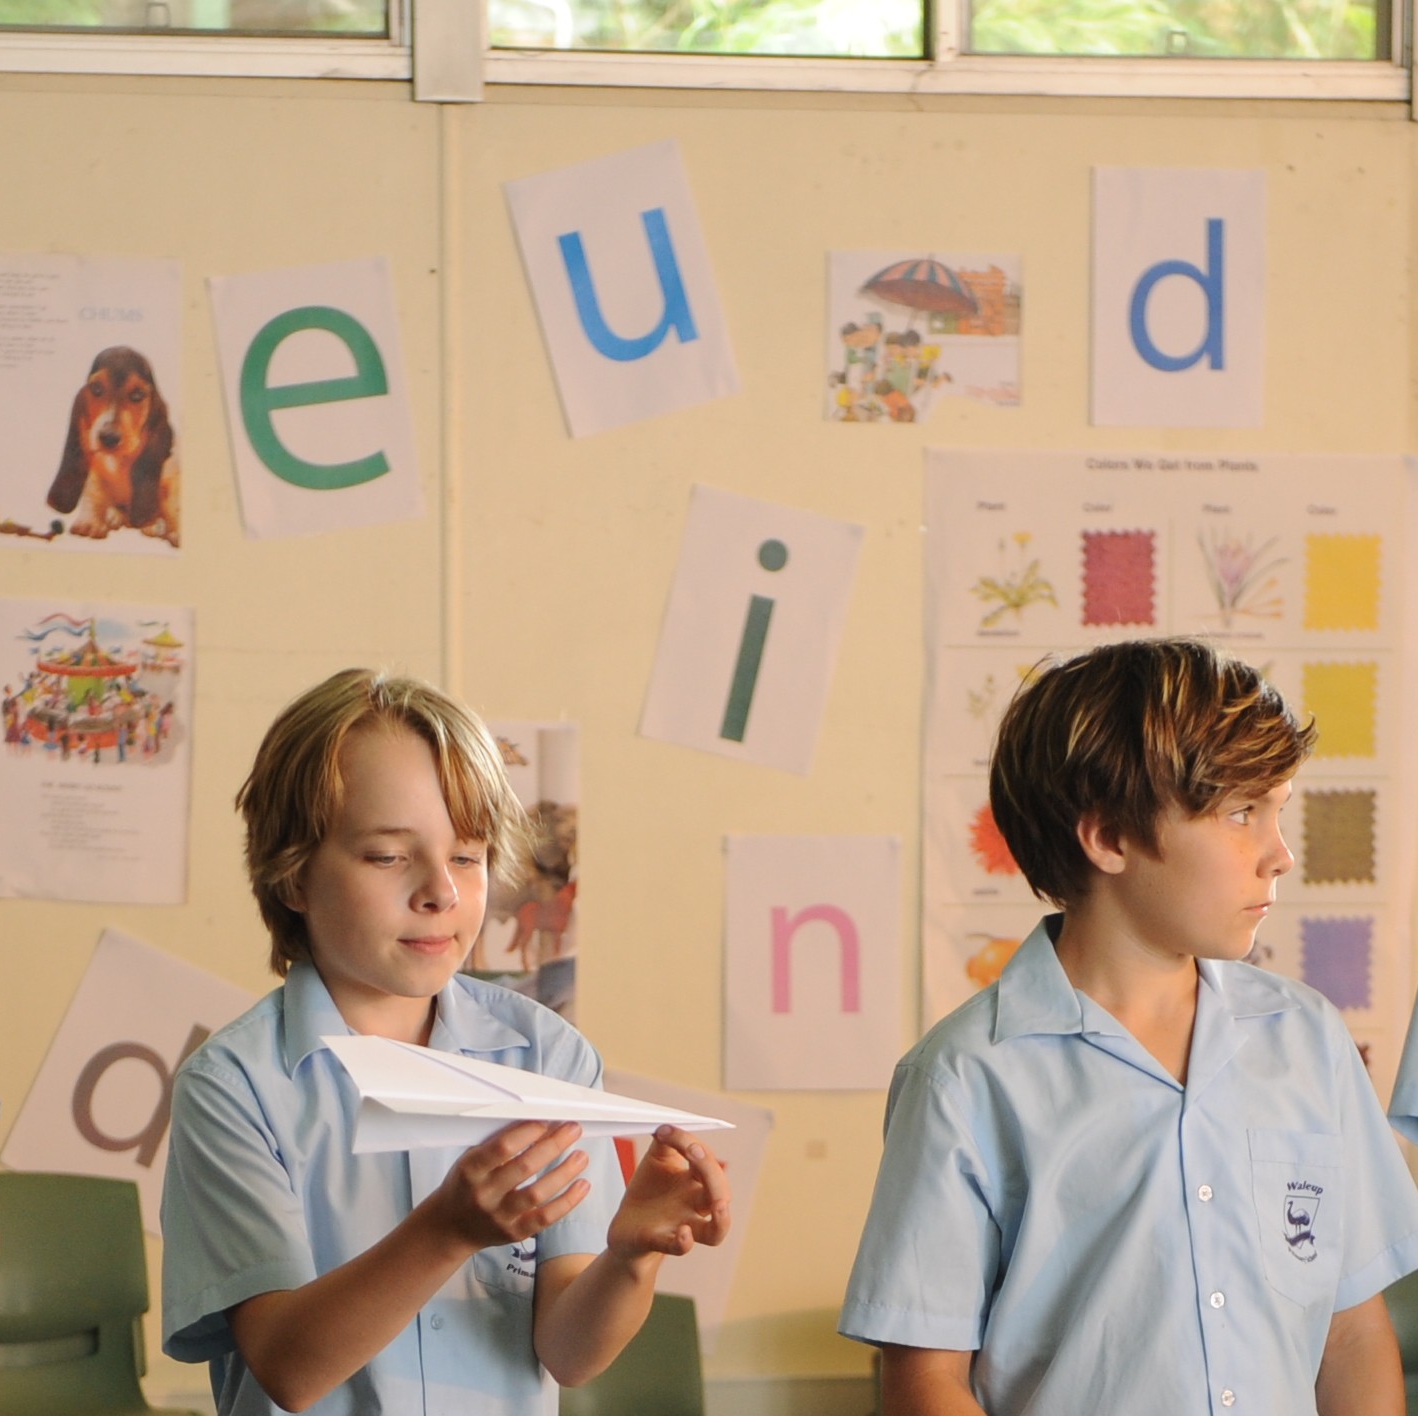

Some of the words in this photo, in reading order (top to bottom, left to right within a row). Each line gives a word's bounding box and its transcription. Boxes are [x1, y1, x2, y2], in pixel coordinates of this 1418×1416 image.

[557, 207, 699, 363] u
[1128, 217, 1225, 373] d
[238, 305, 391, 491] e
[718, 538, 789, 744] i
[773, 906, 859, 1013] n
[506, 1263, 535, 1278] Prima
